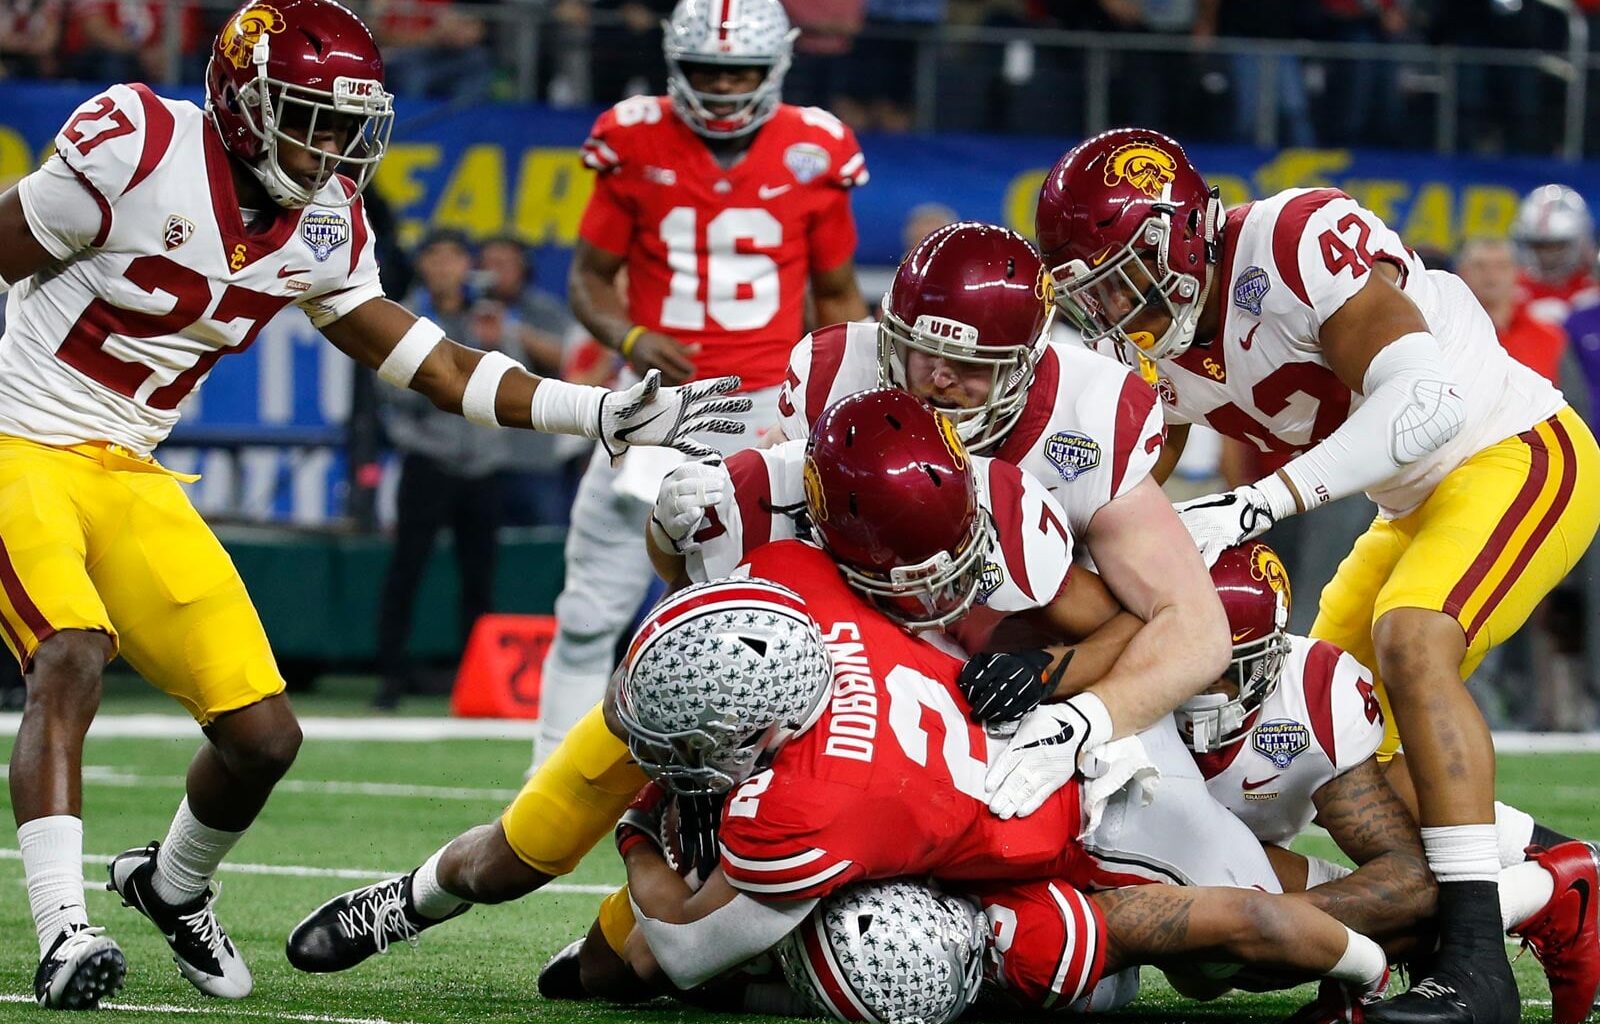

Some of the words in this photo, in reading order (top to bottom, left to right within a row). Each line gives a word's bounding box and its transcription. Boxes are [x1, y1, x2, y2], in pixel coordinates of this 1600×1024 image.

[348, 81, 373, 96] USC
[63, 96, 136, 156] 27
[304, 223, 346, 241] COTTON
[1318, 212, 1373, 279] 42
[659, 205, 783, 332] 16
[55, 254, 295, 410] 27
[930, 320, 963, 340] USC
[1049, 441, 1098, 465] COTTON
[1052, 435, 1097, 449] GOODYEAR
[1039, 499, 1068, 547] 7
[821, 621, 878, 763] DOBBINS
[884, 663, 989, 806] 2
[1256, 732, 1306, 750] COTTON
[1257, 724, 1304, 733] GOODYEAR
[728, 768, 775, 819] 2
